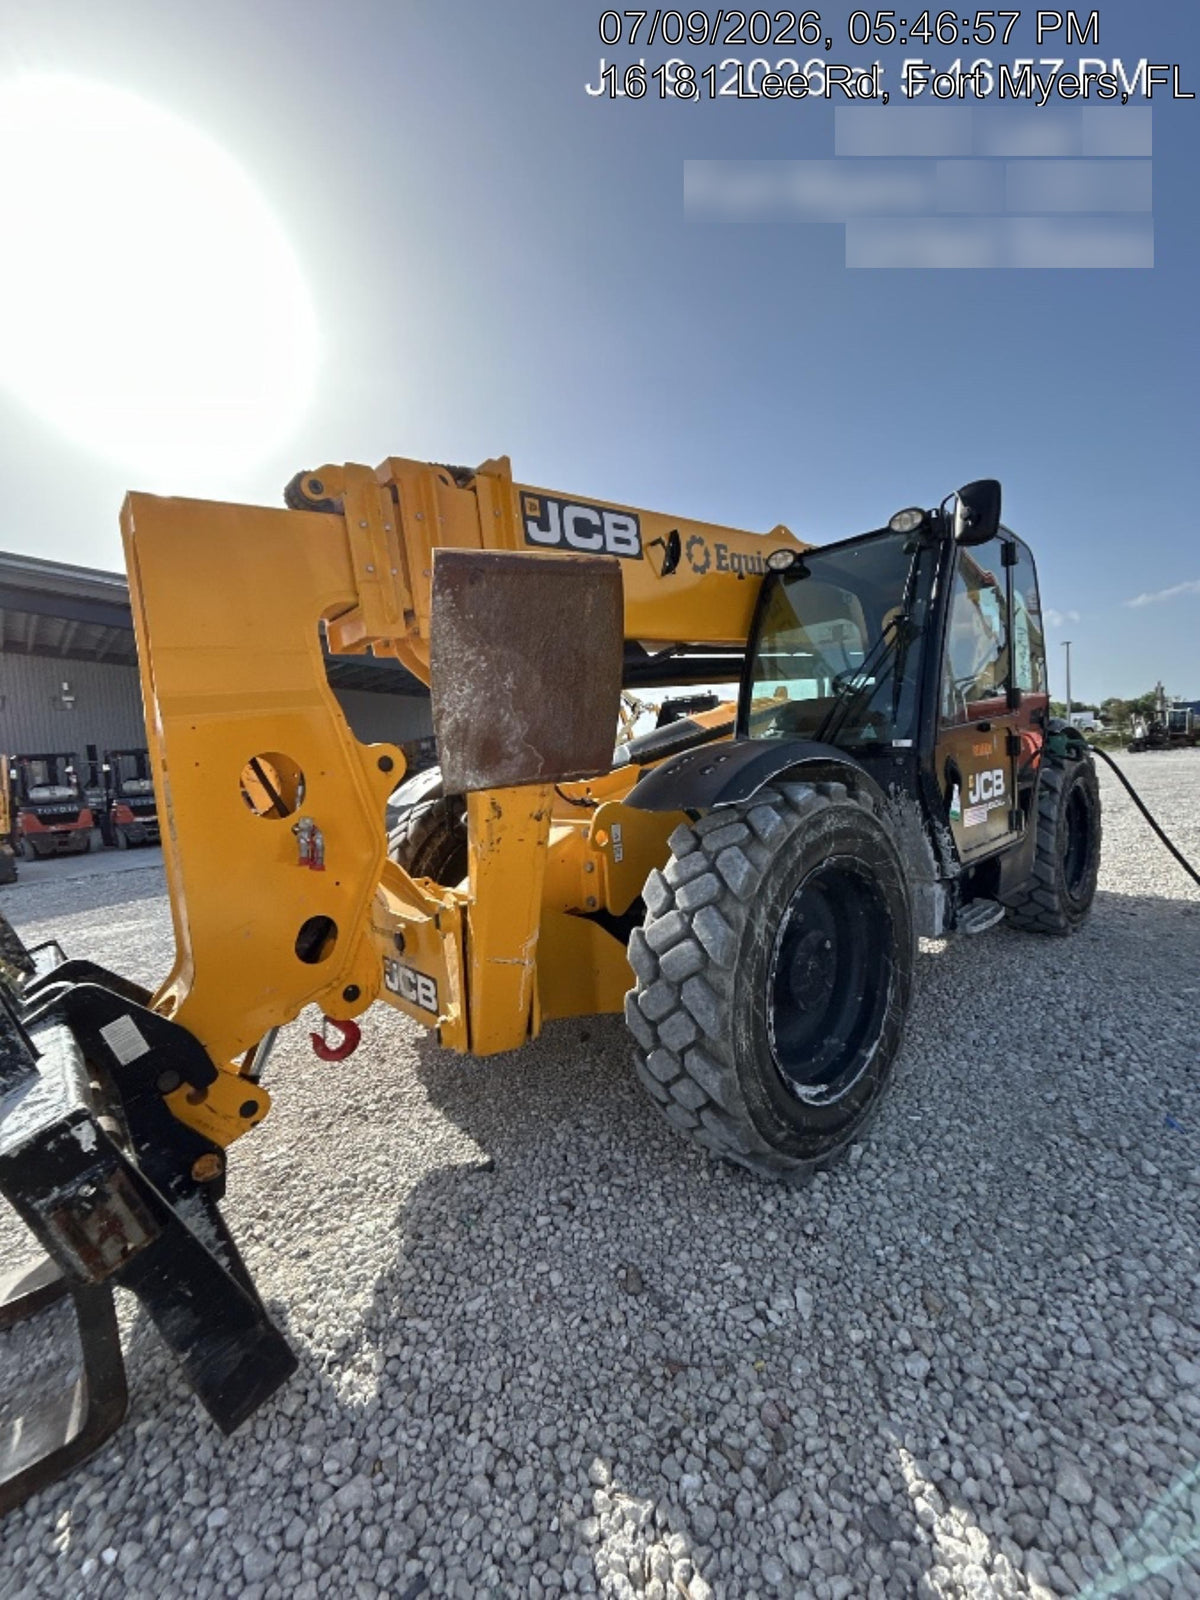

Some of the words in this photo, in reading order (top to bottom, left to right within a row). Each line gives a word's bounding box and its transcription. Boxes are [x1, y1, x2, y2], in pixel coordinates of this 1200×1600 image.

[525, 500, 641, 556] JCB
[968, 768, 1005, 804] JCB
[384, 963, 438, 1013] JCB
